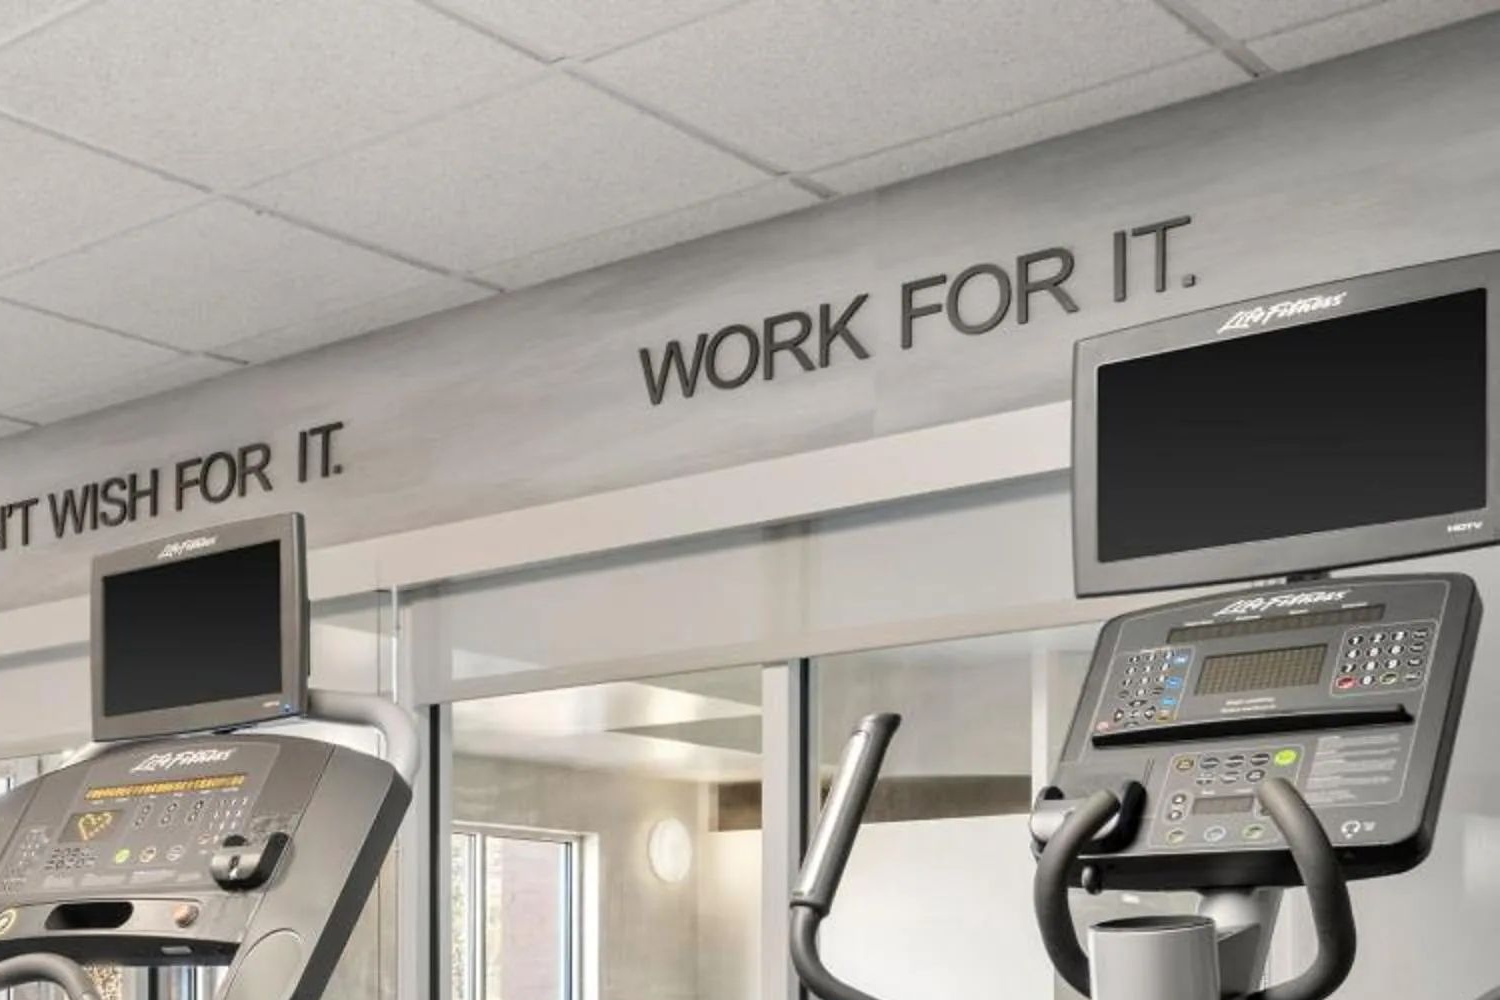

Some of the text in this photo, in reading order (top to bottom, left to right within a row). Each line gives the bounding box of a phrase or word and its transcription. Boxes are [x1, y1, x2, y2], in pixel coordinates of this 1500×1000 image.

[638, 214, 1197, 406] WORK FOR IT.
[47, 468, 160, 540] WISH
[174, 441, 274, 513] FOR
[297, 421, 345, 483] IT.
